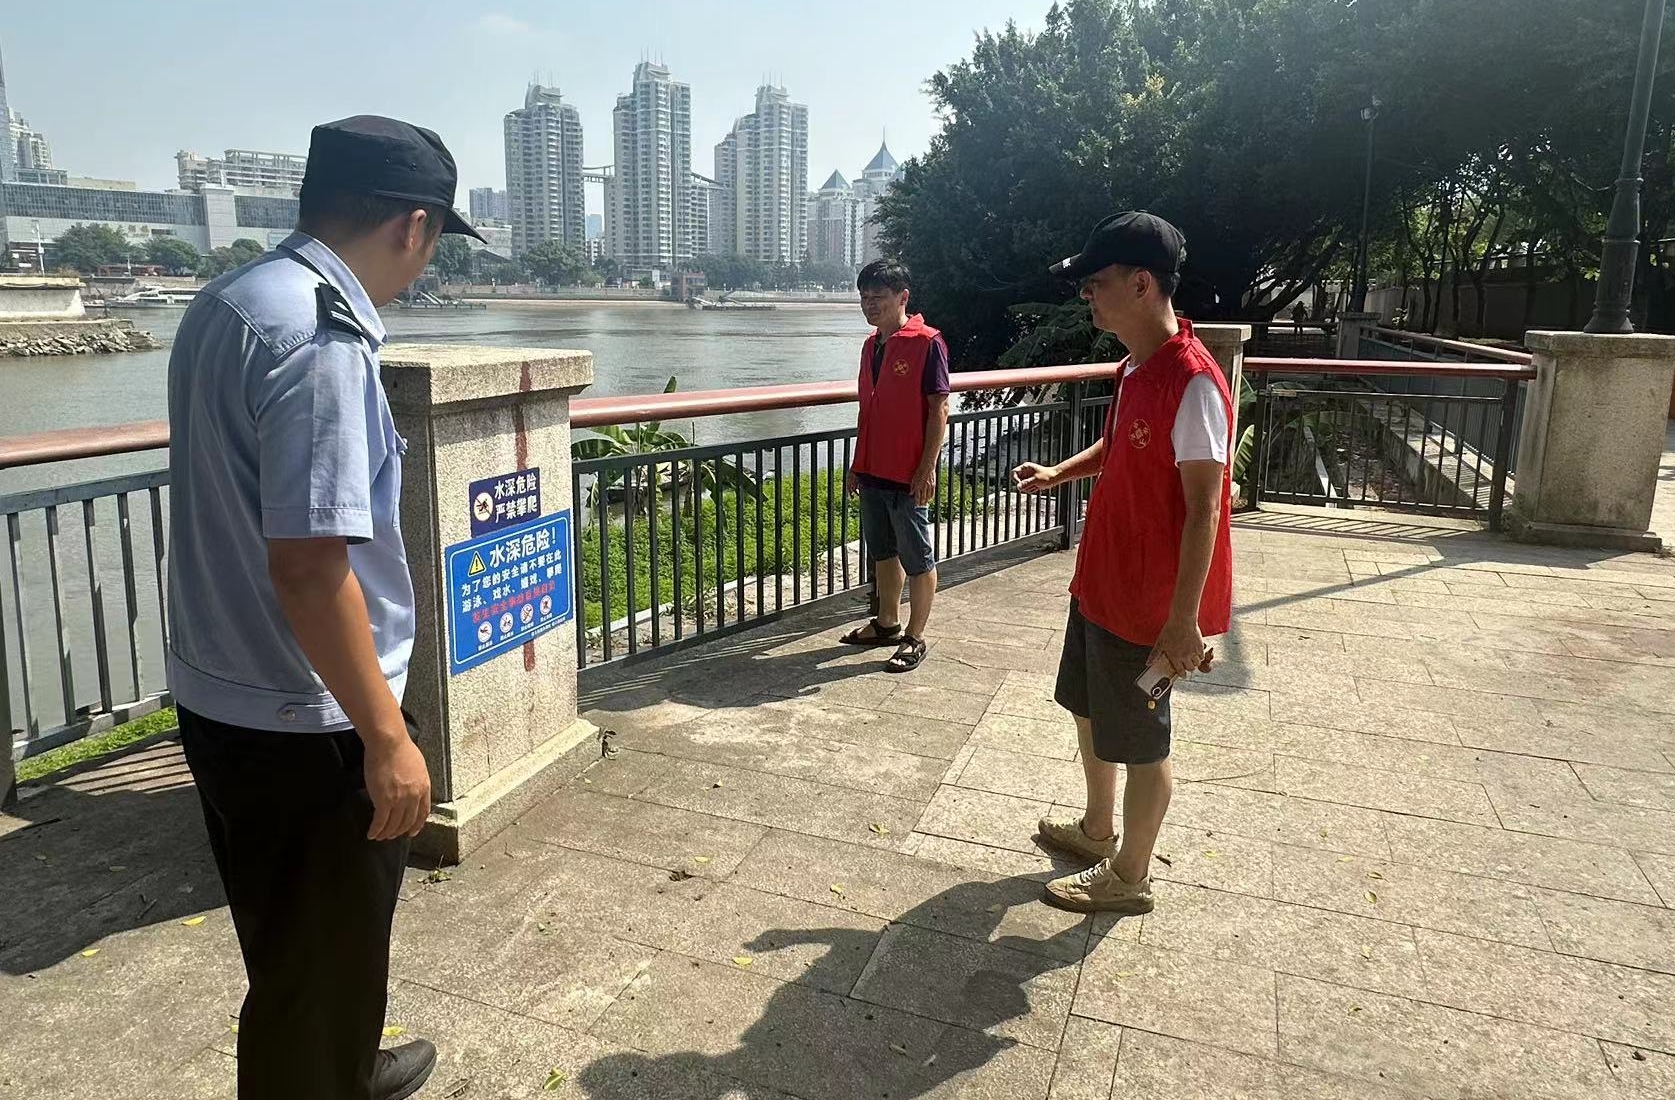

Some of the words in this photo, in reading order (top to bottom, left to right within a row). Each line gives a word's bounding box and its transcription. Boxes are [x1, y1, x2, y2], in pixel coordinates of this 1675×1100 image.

[494, 475, 538, 500] 水深危险
[495, 497, 538, 523] 严禁攀爬
[489, 527, 556, 568] 水深危险！
[461, 549, 562, 597] 为了您的安全请不要在此
